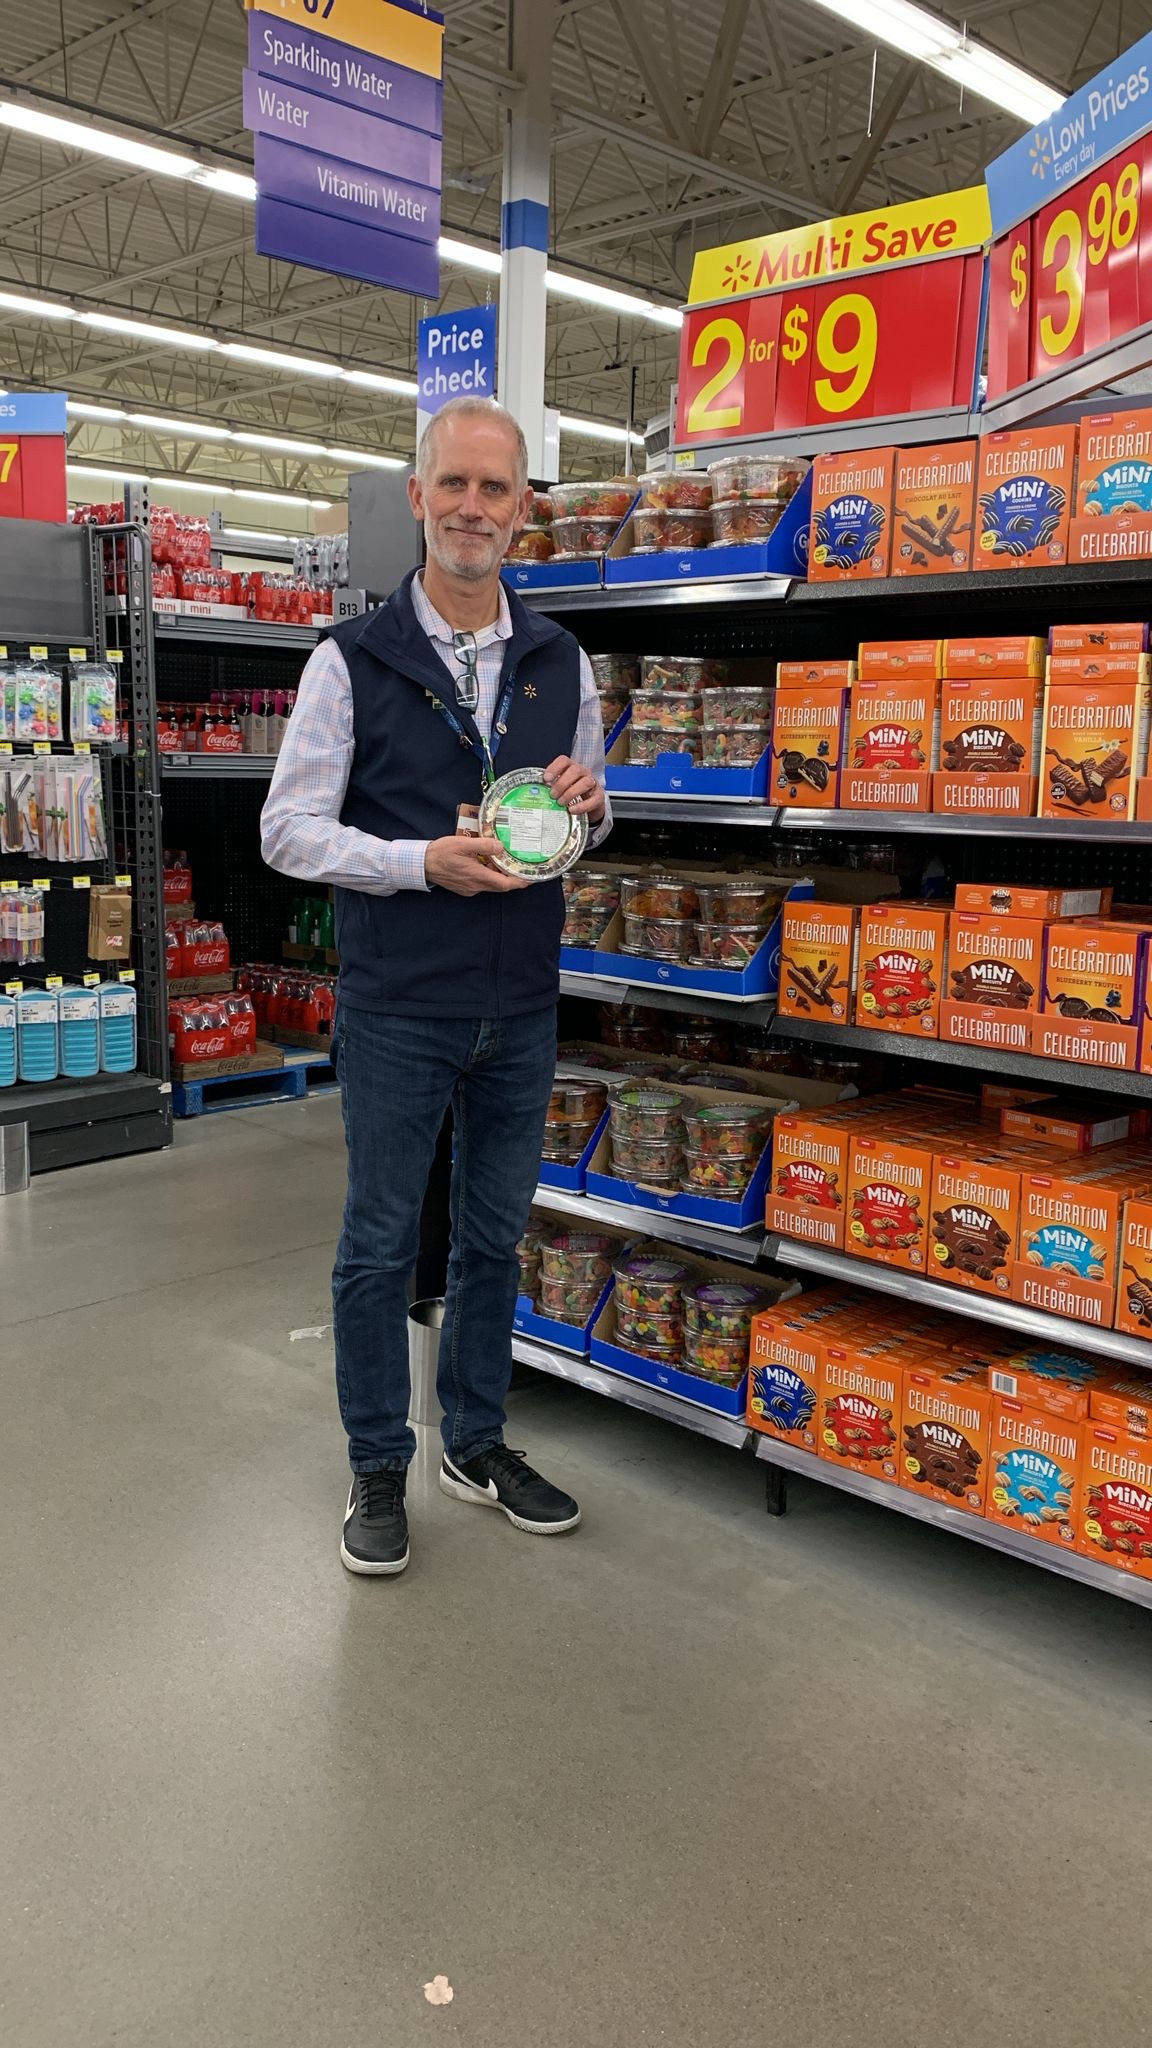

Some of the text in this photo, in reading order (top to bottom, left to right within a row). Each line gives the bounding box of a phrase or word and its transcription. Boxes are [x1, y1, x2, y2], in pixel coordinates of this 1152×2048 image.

[264, 30, 393, 100] Sparkling Water
[258, 88, 310, 128] Water
[1049, 65, 1150, 160] Low Prices
[1054, 141, 1096, 181] Every day
[317, 166, 428, 223] Vitamin Water
[754, 219, 957, 287] Multi Save
[427, 325, 484, 358] Price
[423, 359, 487, 397] check
[687, 318, 746, 433] 2
[748, 338, 776, 364] for
[154, 601, 176, 612] mini
[190, 603, 212, 614] mini
[339, 602, 358, 617] B13
[1056, 976, 1123, 990] BLUEBERRY TRUFFLE
